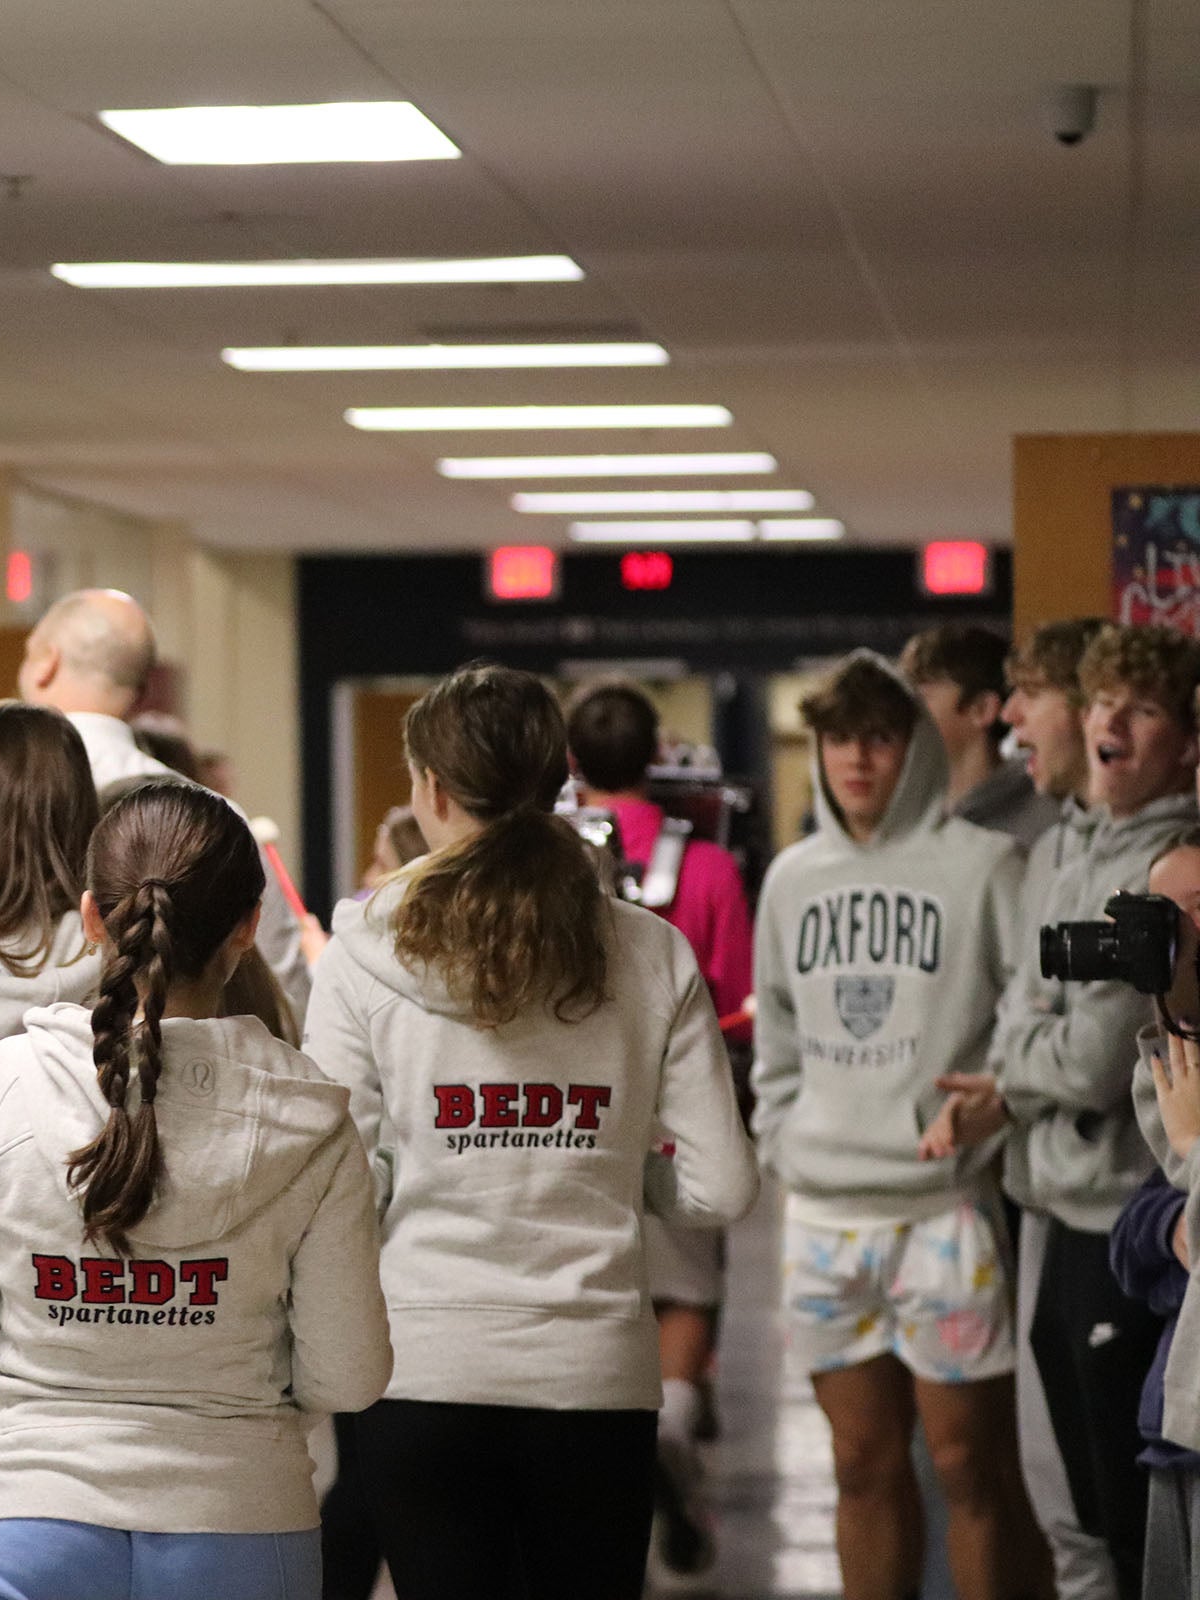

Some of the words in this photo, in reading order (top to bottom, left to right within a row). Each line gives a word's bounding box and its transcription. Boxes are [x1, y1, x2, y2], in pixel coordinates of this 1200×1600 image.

[797, 889, 941, 974] OXFORD
[433, 1083, 612, 1130] BEDT
[446, 1128, 598, 1155] spartanettes
[31, 1253, 229, 1306] BEDT
[47, 1304, 216, 1327] spartanettes
